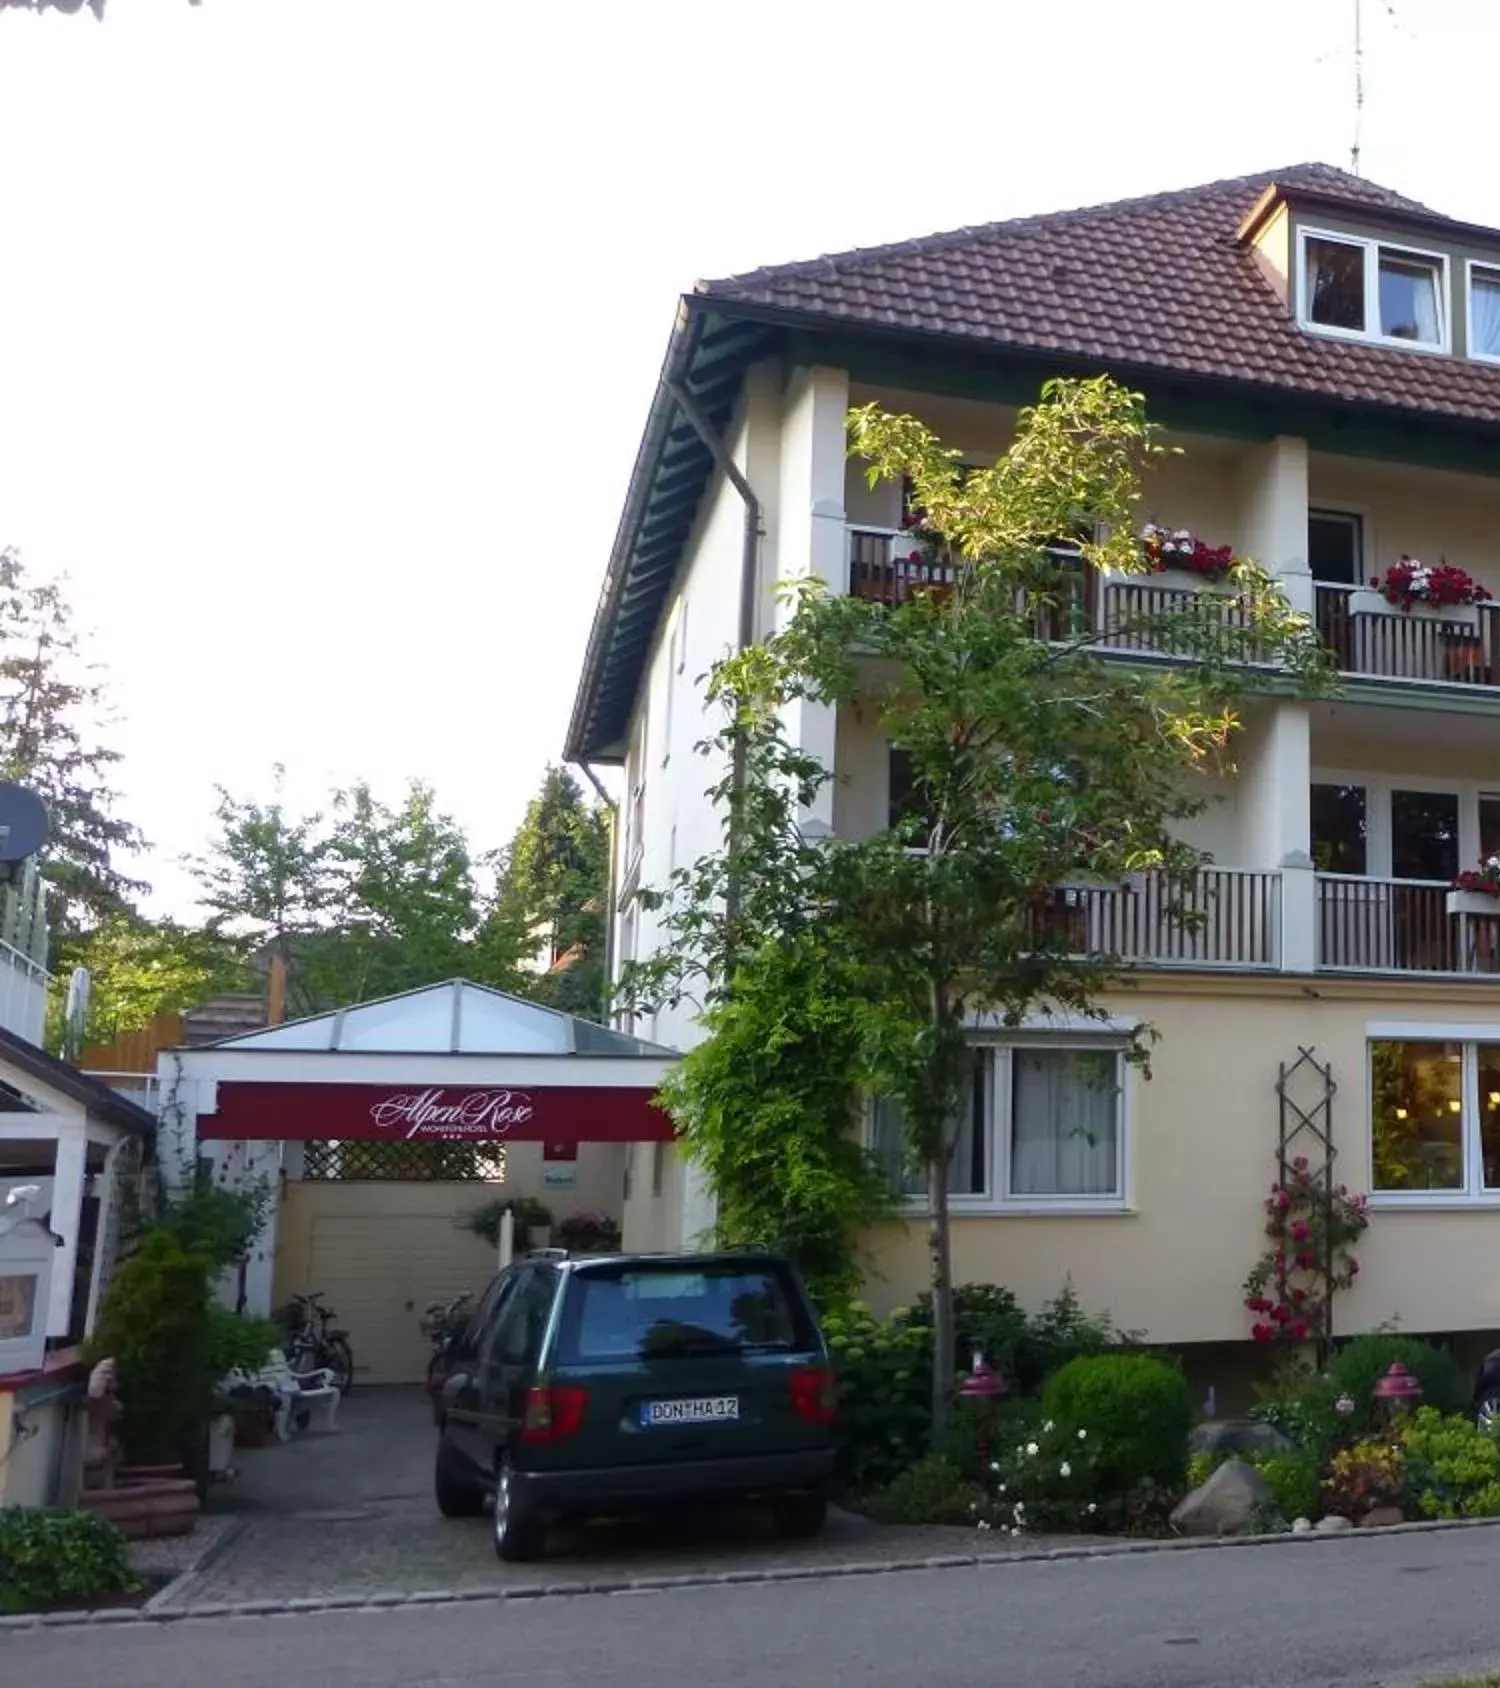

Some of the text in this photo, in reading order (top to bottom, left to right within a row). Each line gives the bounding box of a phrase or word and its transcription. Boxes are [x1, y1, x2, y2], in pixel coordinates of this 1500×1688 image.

[370, 1088, 534, 1139] Alpen Rose
[653, 1403, 683, 1419] DON
[717, 1400, 737, 1415] 12
